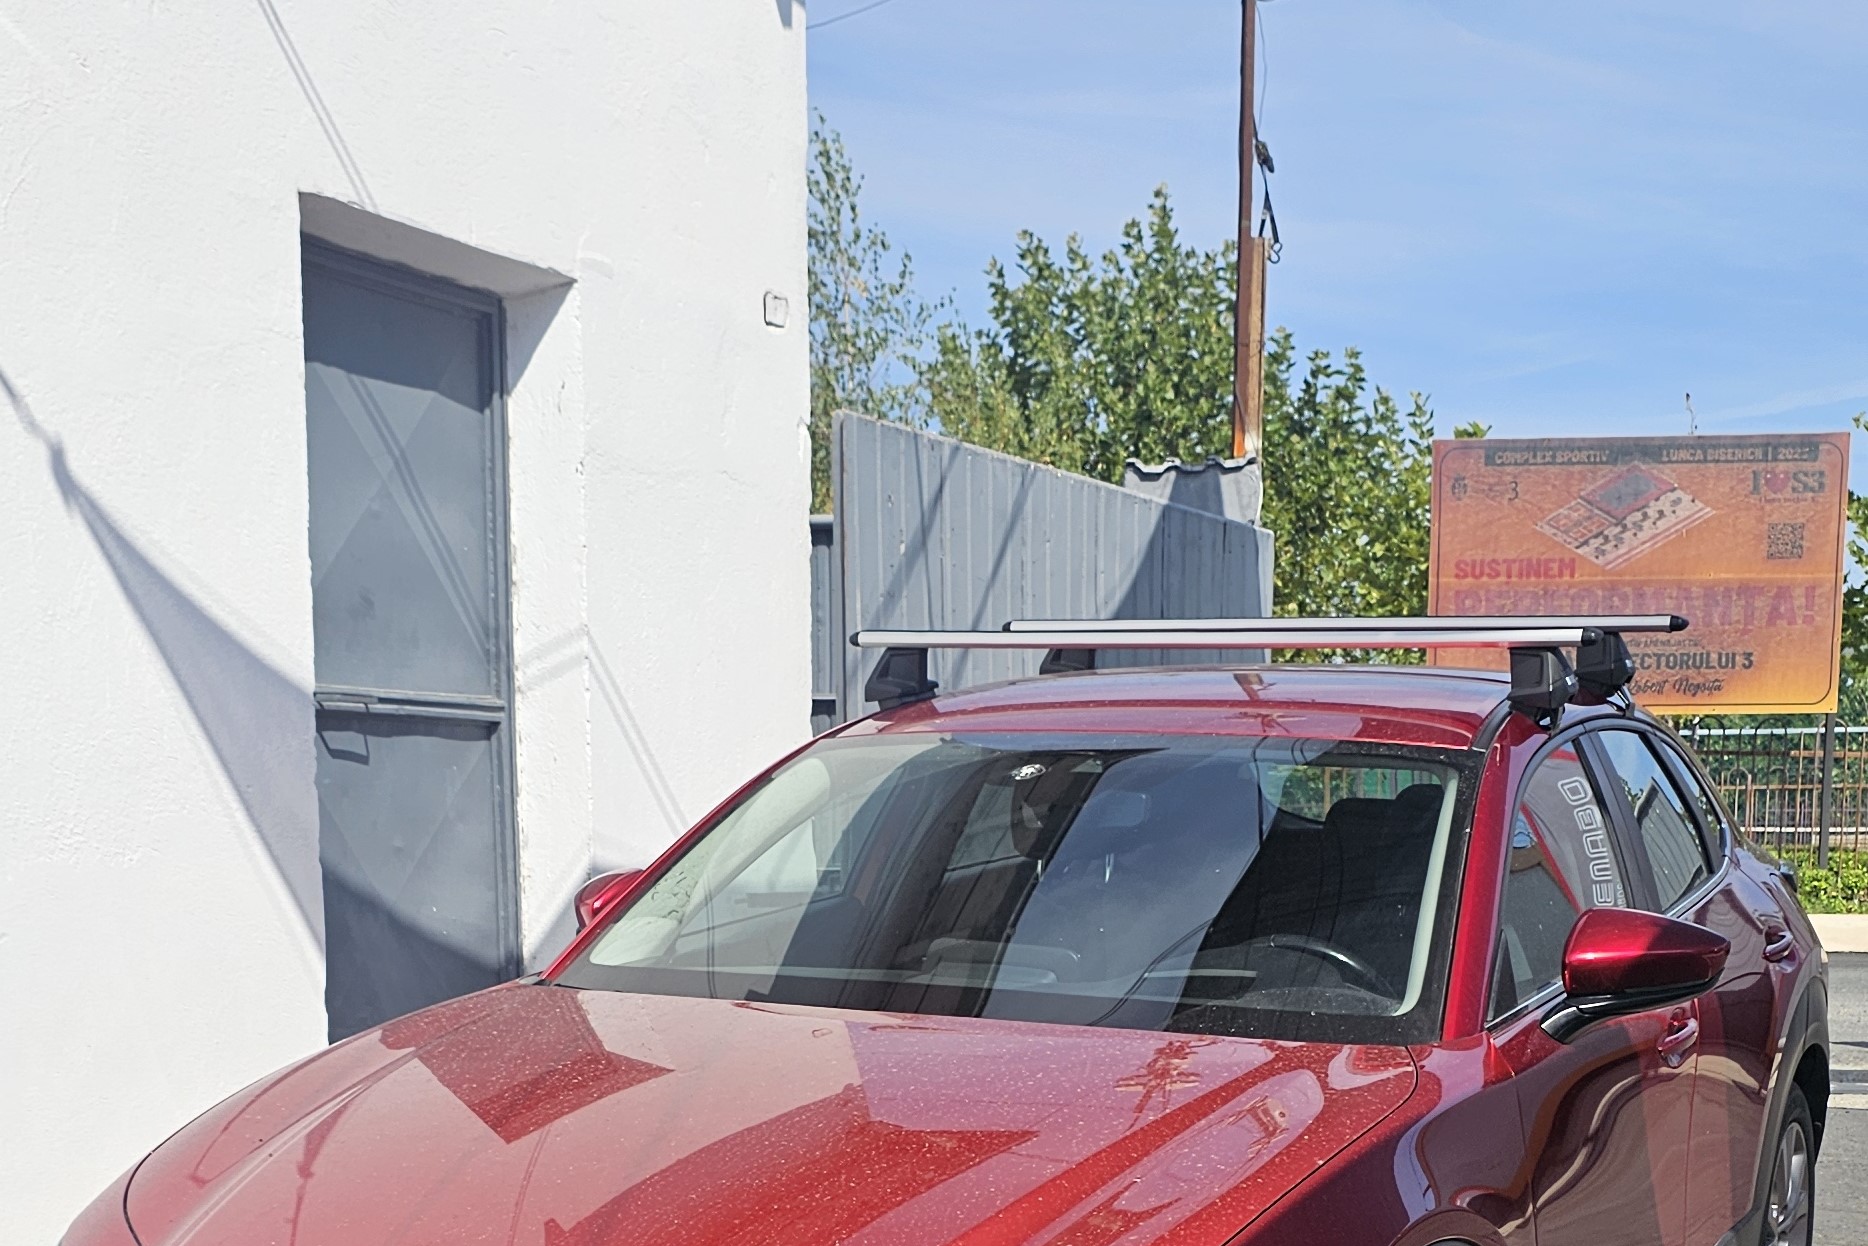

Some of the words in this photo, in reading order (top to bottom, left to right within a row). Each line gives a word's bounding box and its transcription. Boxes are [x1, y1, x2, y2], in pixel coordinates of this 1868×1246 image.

[1494, 451, 1552, 464] COMPLEX
[1555, 450, 1609, 463] SPORTIV
[1661, 448, 1704, 461] LUNCA
[1507, 480, 1519, 501] 3
[1630, 652, 1737, 670] ECTORULUI
[1742, 652, 1754, 670] 3
[1557, 776, 1614, 906] ENABO
